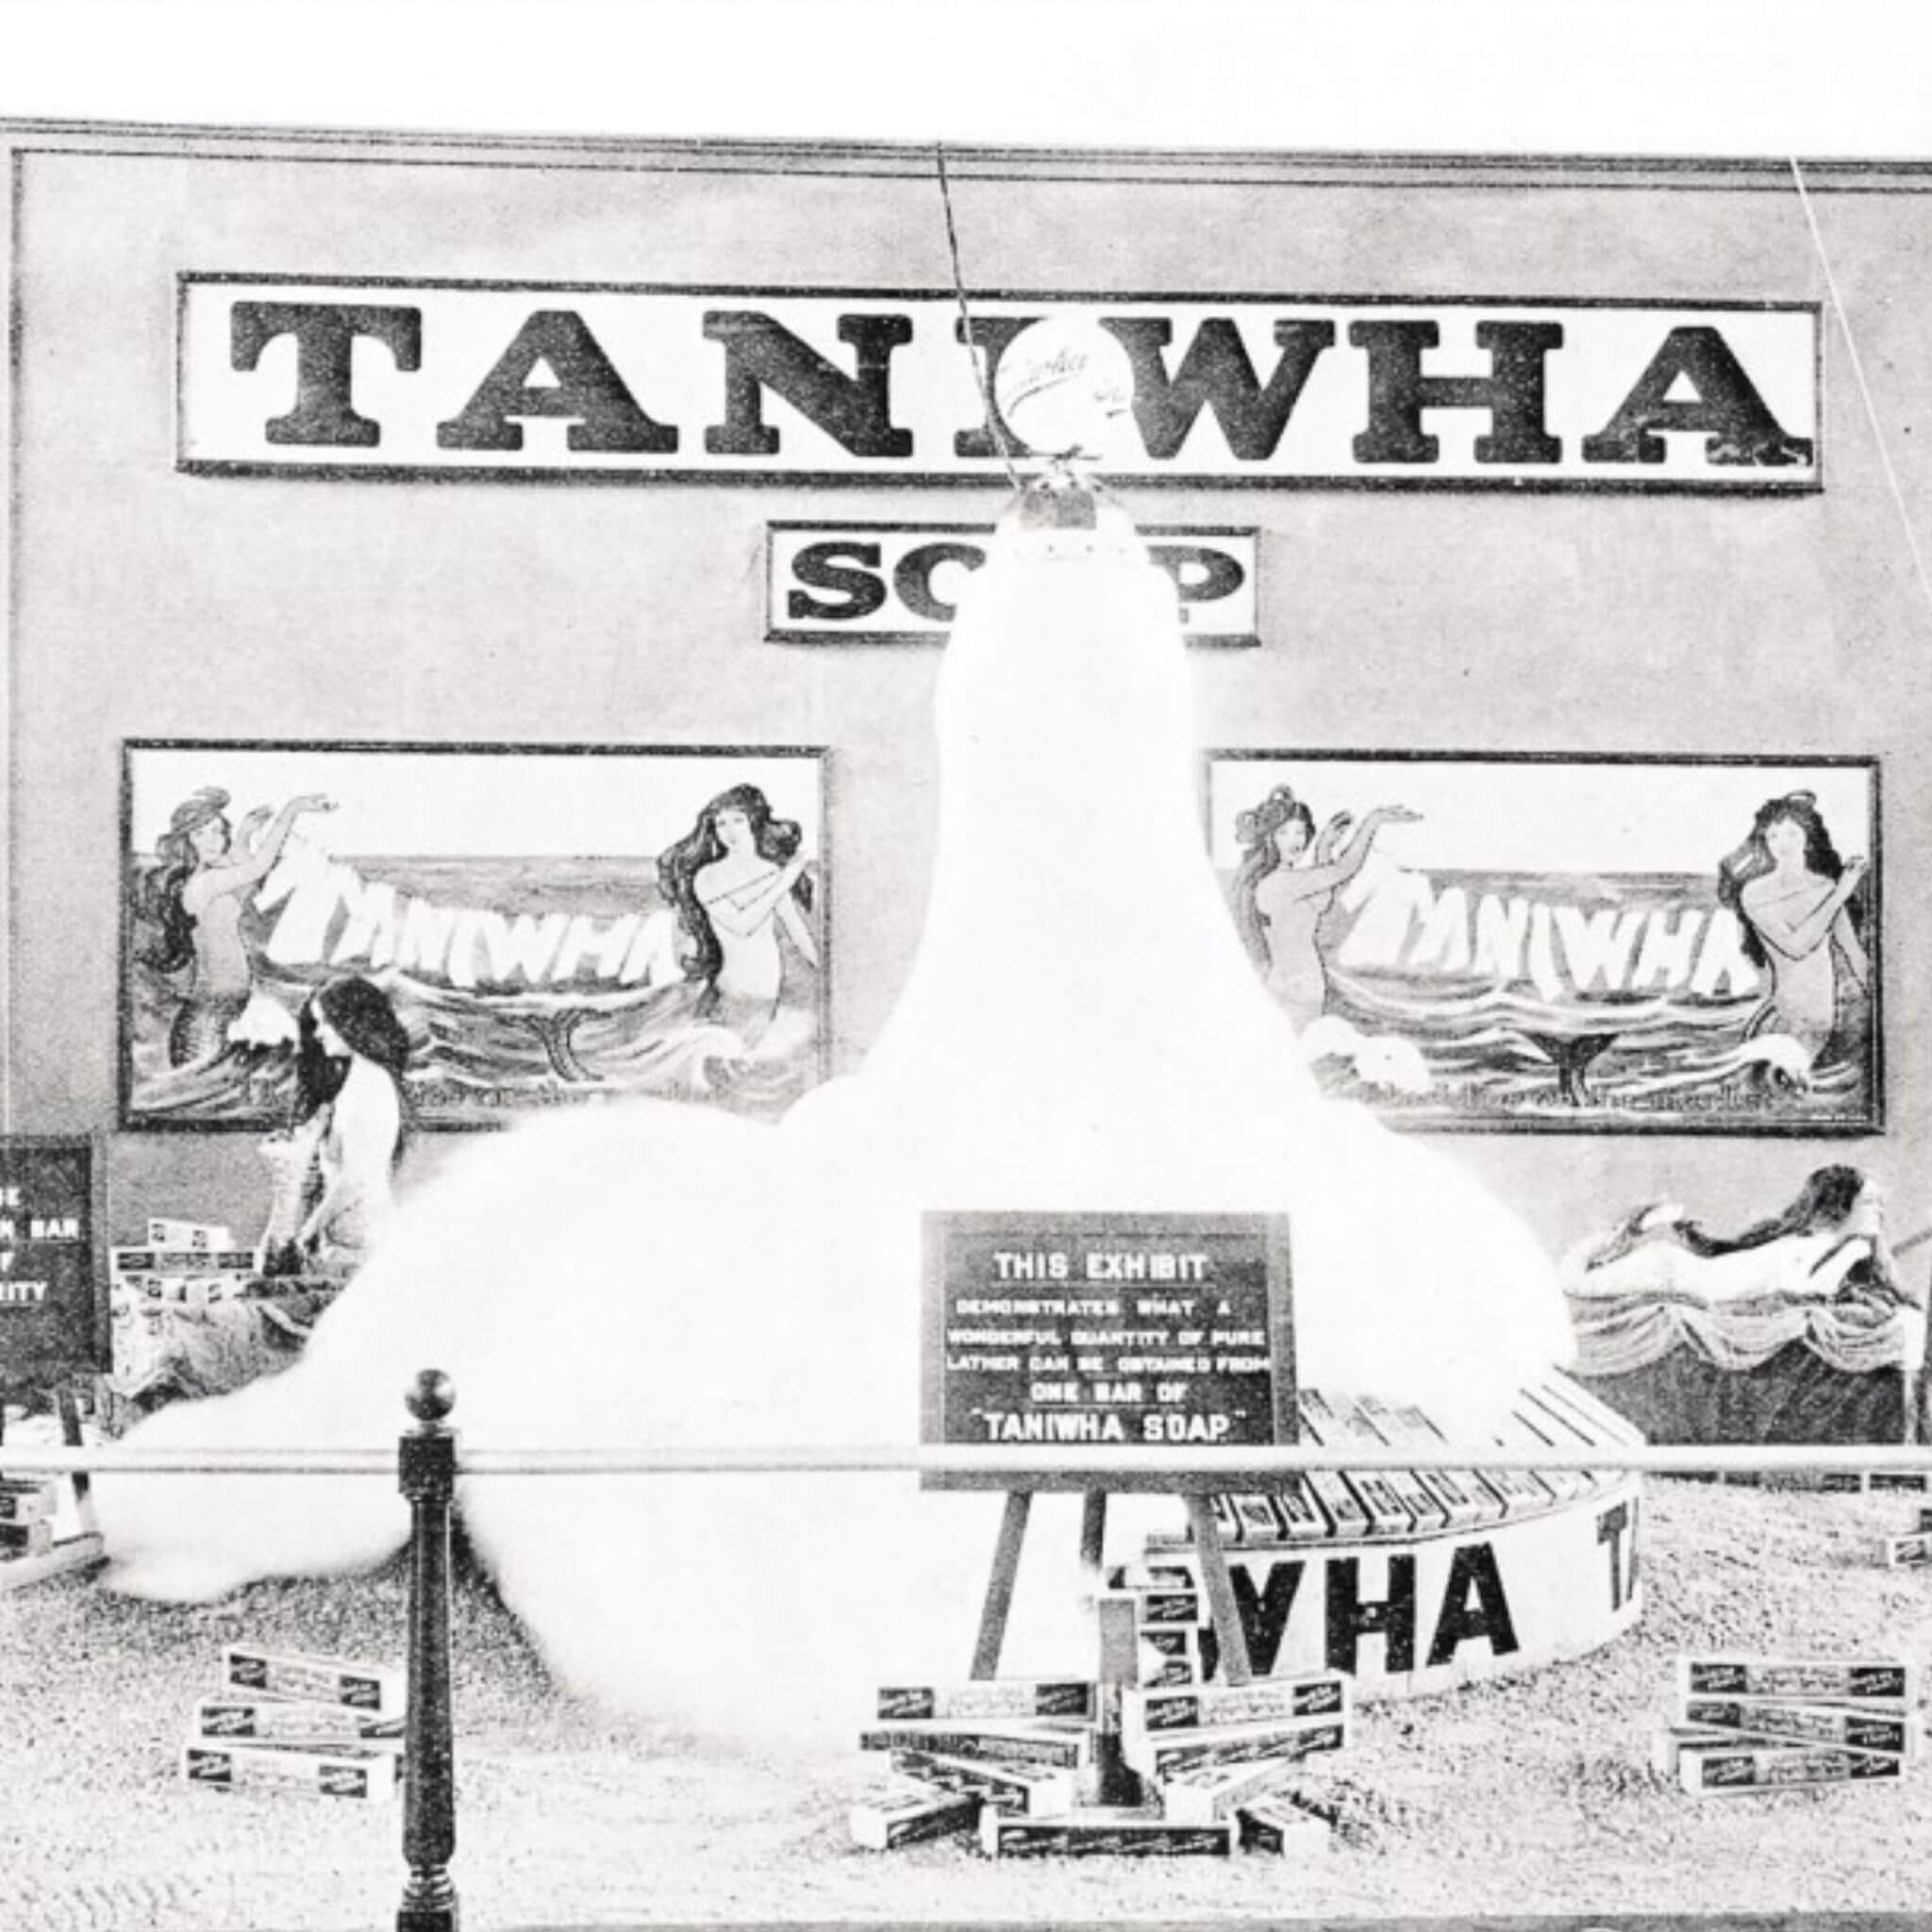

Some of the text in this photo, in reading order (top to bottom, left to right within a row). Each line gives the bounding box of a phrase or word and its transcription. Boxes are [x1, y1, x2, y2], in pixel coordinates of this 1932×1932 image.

[229, 300, 1813, 467] TANIWHA
[788, 541, 1246, 624] SOP
[1339, 840, 1761, 1002] TANIWHA
[993, 1252, 1208, 1280] THIS EXHIBIT
[956, 1298, 1231, 1316] DEMONSTRATES WHAT A
[946, 1328, 1266, 1346] WONDERFUL QUANTITY OF PURE
[946, 1356, 1271, 1374] LATHER CAN BE OBTAINED FROM
[1030, 1382, 1189, 1403] ONE BAR OF
